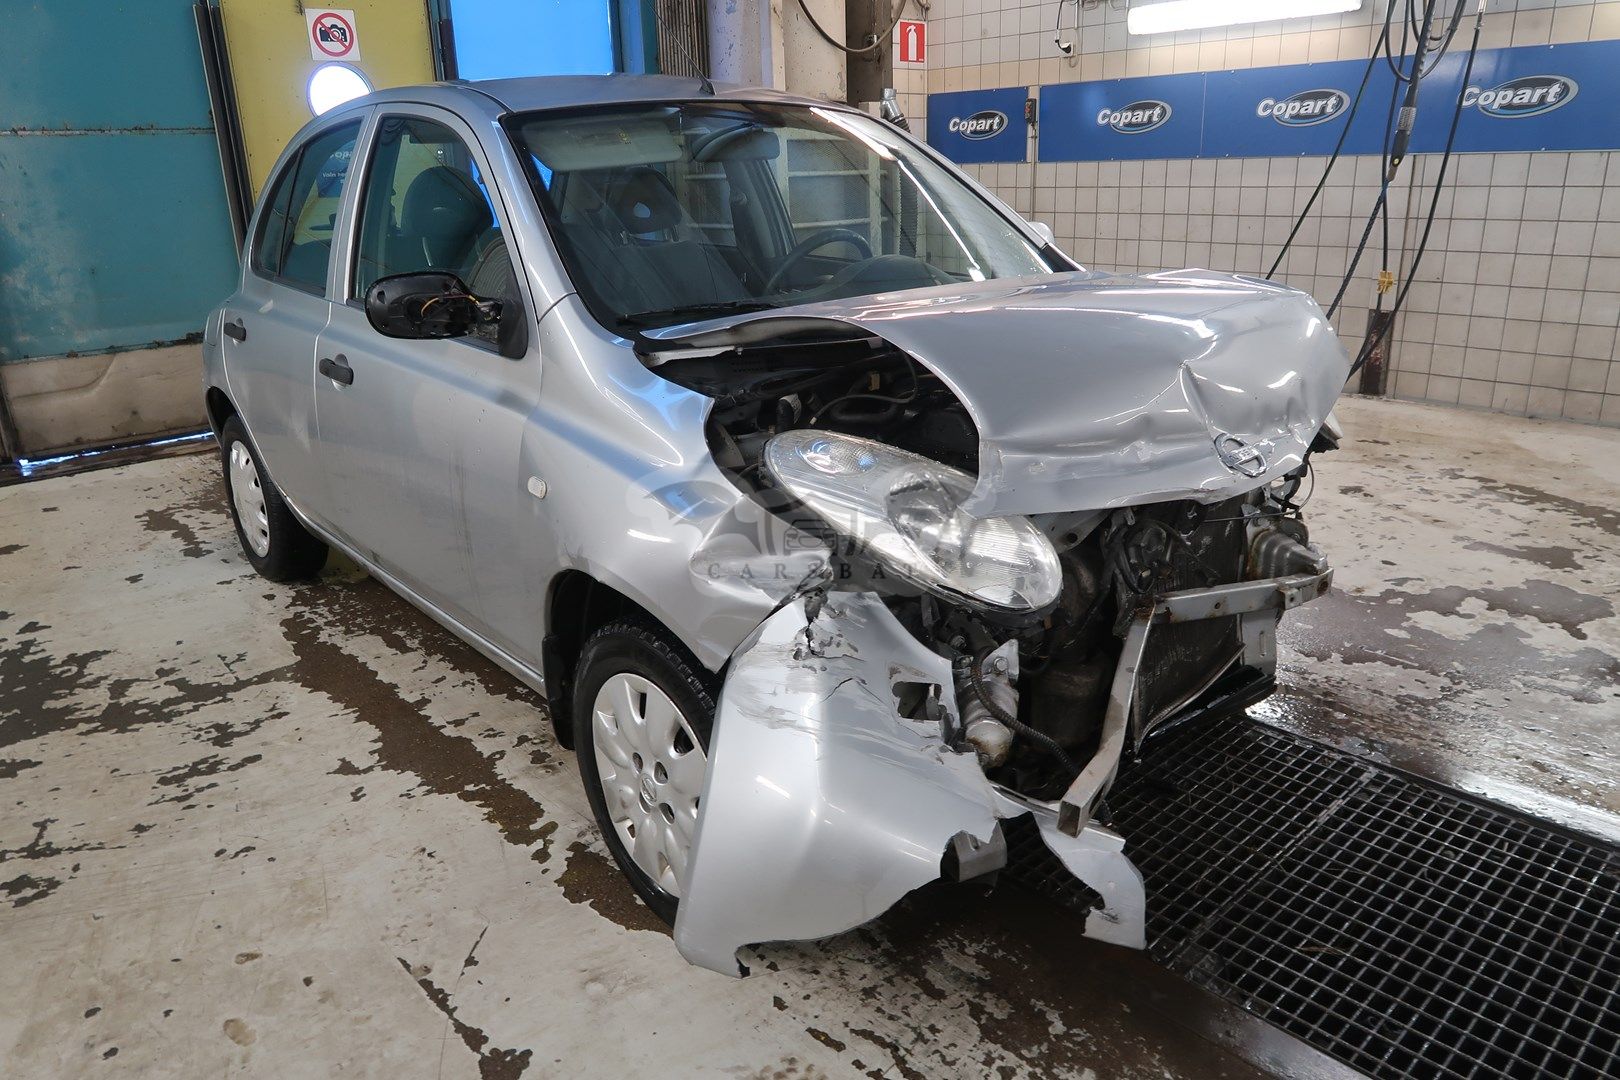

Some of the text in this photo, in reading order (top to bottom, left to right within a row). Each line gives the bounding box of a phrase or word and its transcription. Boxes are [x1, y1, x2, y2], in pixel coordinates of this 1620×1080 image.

[1461, 82, 1562, 109] Copart
[1097, 105, 1162, 126] Copart
[1257, 96, 1337, 119] Copart
[949, 116, 1001, 134] Copart
